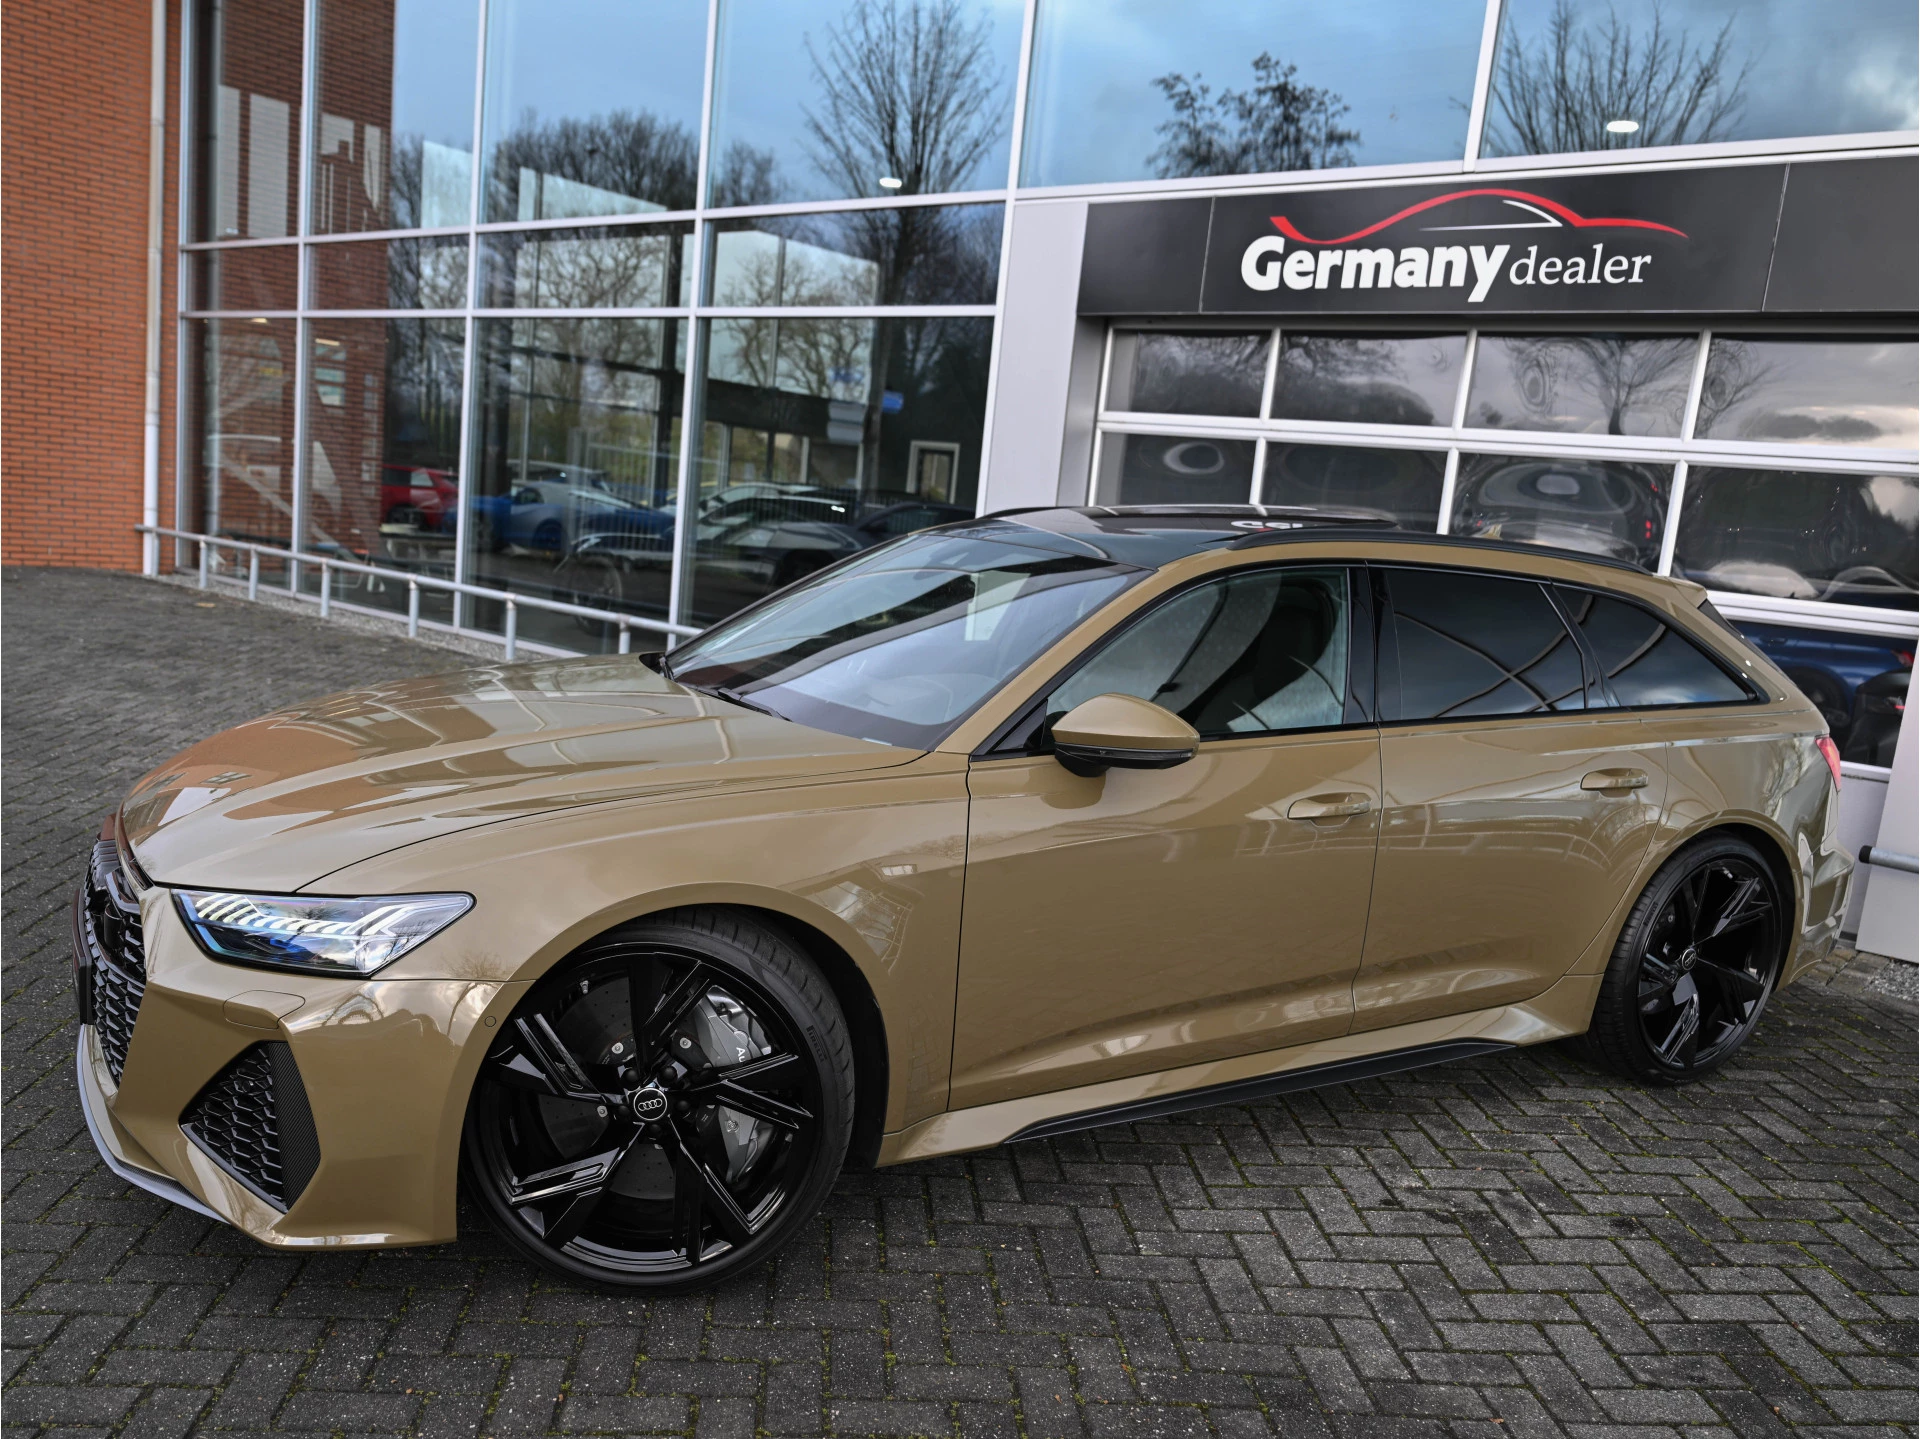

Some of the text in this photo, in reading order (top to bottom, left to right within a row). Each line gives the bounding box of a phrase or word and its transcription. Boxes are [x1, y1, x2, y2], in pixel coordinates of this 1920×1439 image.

[1241, 235, 1652, 302] Germany dealer
[736, 1047, 746, 1063] Au
